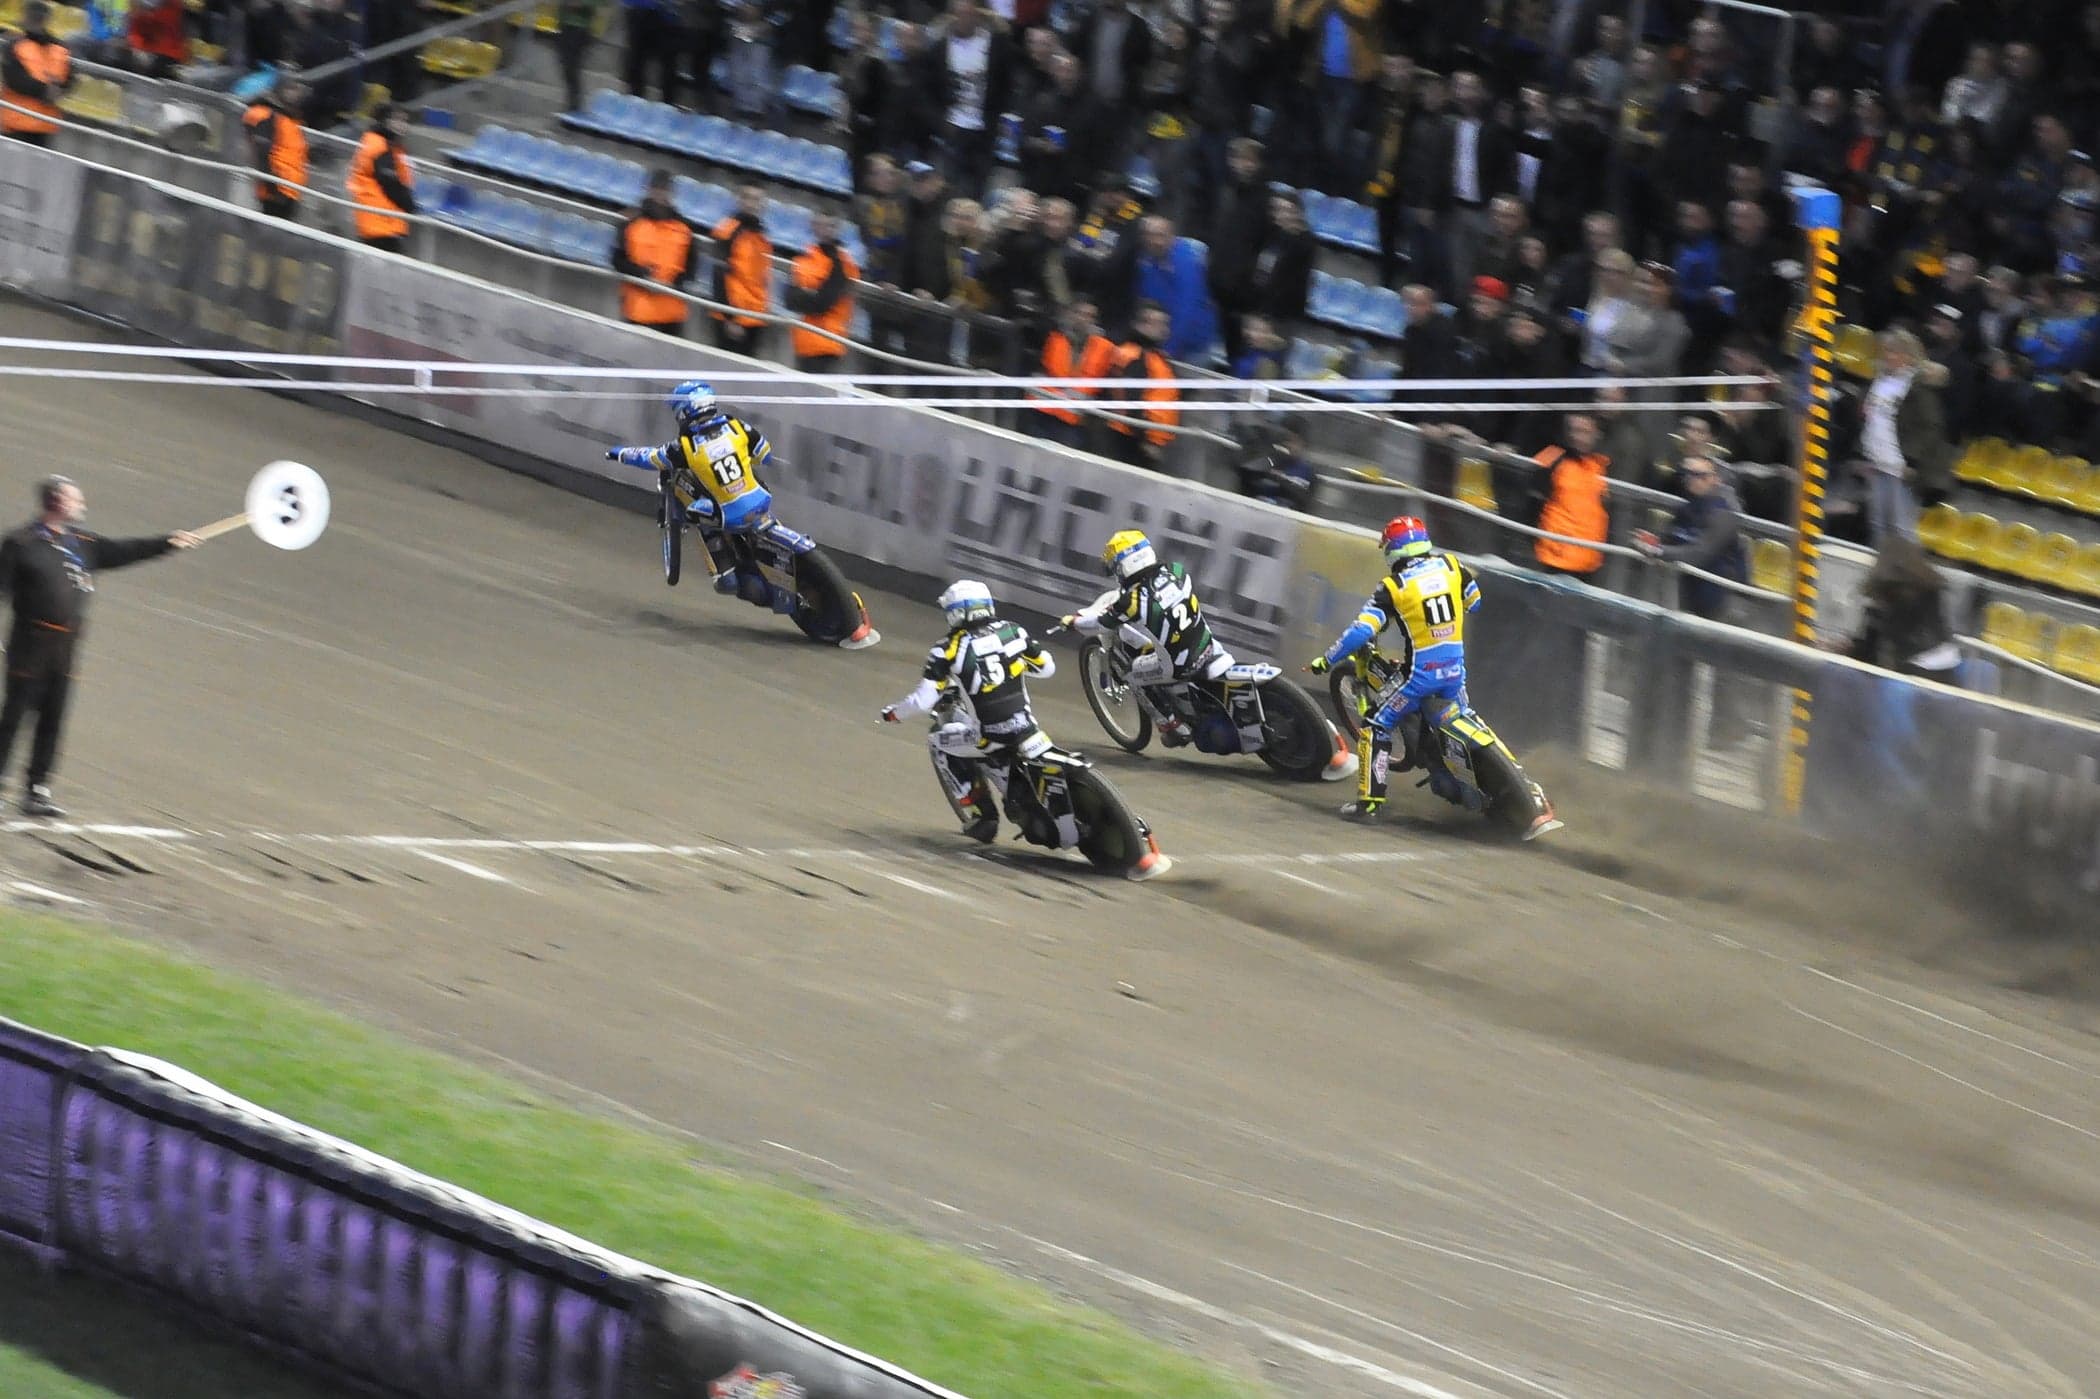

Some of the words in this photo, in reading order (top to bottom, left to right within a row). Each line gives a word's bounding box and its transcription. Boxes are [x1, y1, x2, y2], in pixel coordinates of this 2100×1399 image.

[713, 455, 742, 485] 13
[279, 485, 303, 525] 3
[1172, 603, 1193, 631] 2
[1425, 595, 1452, 625] 11
[985, 654, 1006, 686] 5
